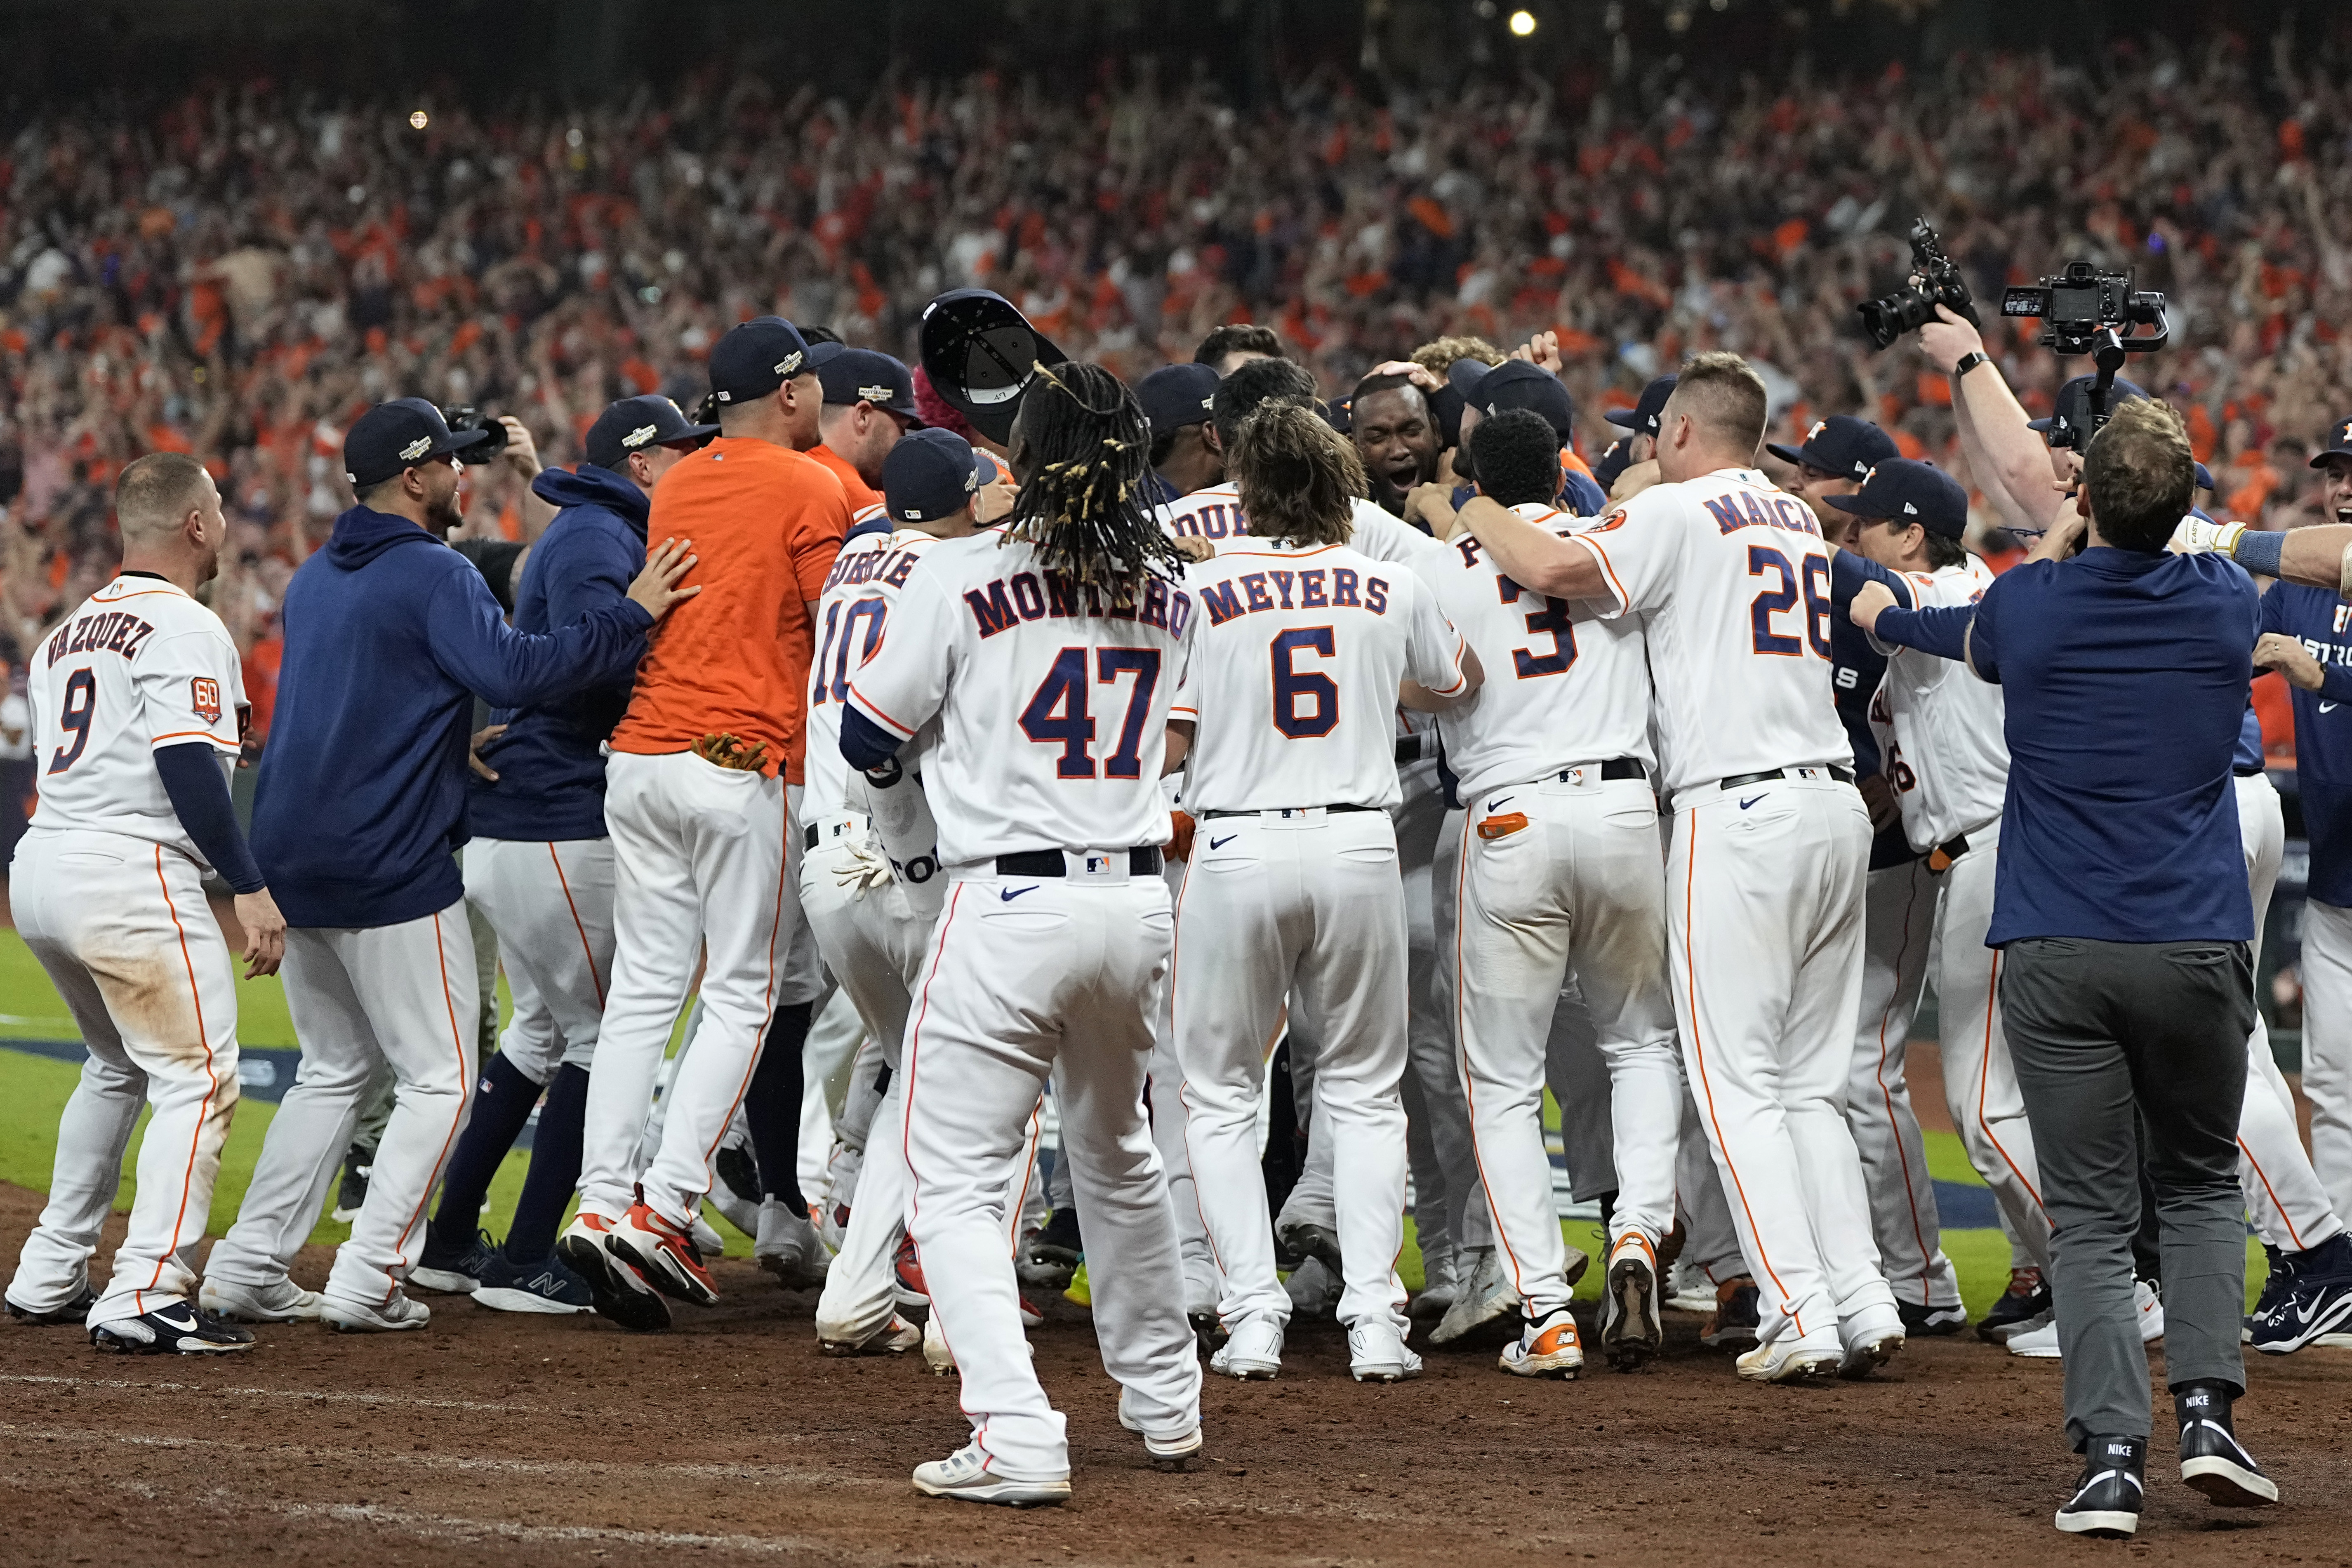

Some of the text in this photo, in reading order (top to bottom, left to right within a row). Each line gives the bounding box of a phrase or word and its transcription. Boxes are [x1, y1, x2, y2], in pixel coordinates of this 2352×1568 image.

[776, 353, 800, 372] POSTSEASON
[994, 392, 1006, 400] 47
[401, 438, 430, 458] POSTSEASON
[1170, 503, 1248, 539] DUB
[822, 550, 921, 596] GURRIE
[963, 569, 1191, 640] MONTERO
[1200, 568, 1389, 626] MEYERS
[1748, 544, 1832, 661] 26
[1496, 574, 1578, 680] 3
[813, 596, 888, 708] 10
[195, 681, 218, 707] 60
[1270, 625, 1339, 739] 6
[47, 666, 96, 775] 9
[1017, 647, 1161, 779] 47
[1556, 1332, 1575, 1344] NB
[2186, 1395, 2209, 1408] NIKE
[2107, 1443, 2132, 1457] NIKE
